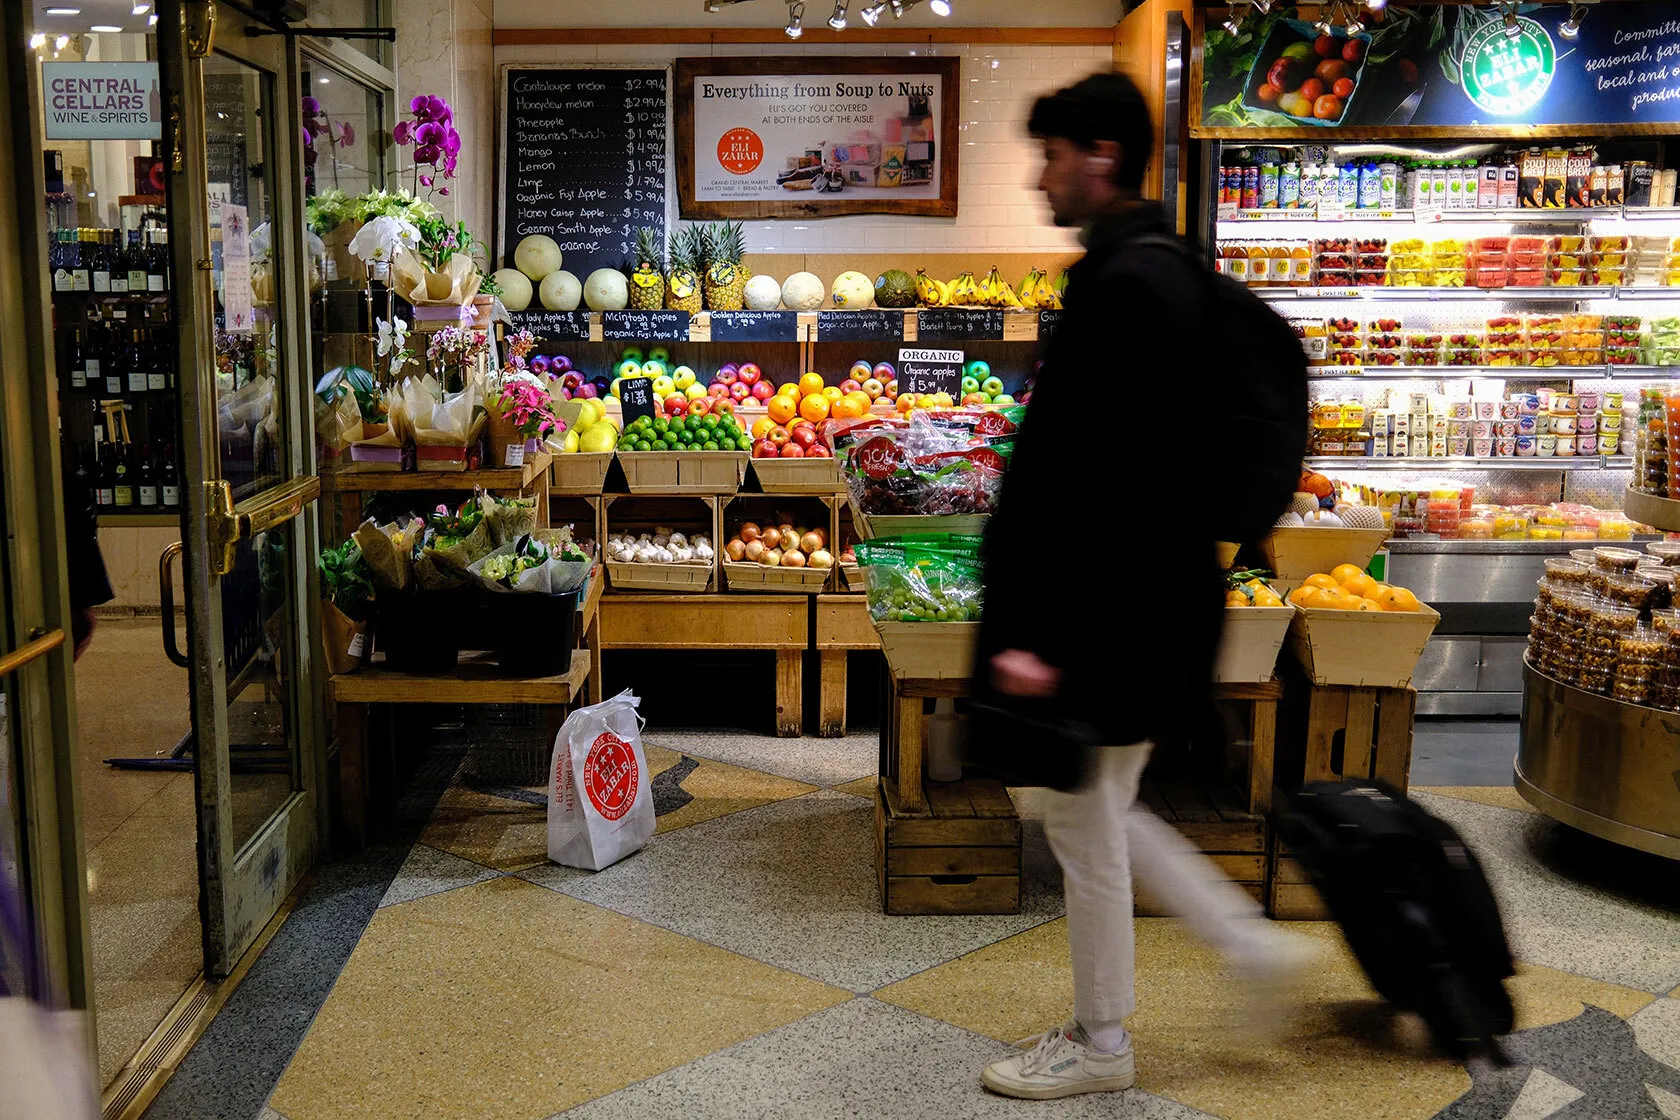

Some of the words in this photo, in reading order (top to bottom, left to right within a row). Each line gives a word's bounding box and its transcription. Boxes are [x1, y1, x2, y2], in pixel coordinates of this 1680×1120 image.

[1465, 37, 1481, 63] NEW
[1481, 21, 1506, 37] YOR
[1518, 20, 1542, 37] CITY
[1585, 46, 1653, 72] seasonal,
[1598, 69, 1637, 91] local
[1637, 65, 1669, 83] and
[52, 78, 145, 93] CENTRAL
[513, 77, 571, 93] Cantaloupe
[577, 81, 606, 91] melon
[703, 84, 788, 100] Everything
[793, 83, 831, 97] from
[836, 82, 874, 99] Soup
[879, 84, 894, 97] to
[898, 82, 934, 97] Nuts
[53, 95, 144, 110] CELLARS
[516, 96, 562, 111] Honeydew
[566, 100, 594, 109] melon
[830, 104, 868, 112] COVERED
[53, 112, 89, 123] WINE
[91, 114, 98, 123] &
[99, 112, 148, 123] SPIRITS
[516, 117, 564, 128] Pineapple
[762, 116, 771, 124] AT
[774, 116, 796, 124] BOTH
[799, 116, 820, 124] ENDS
[854, 115, 874, 123] AISLE
[517, 132, 568, 142] Bananas
[569, 128, 605, 139] Bunch
[519, 147, 552, 157] Mango
[732, 143, 749, 152] ELI
[722, 152, 758, 161] ZABAR
[519, 161, 555, 172] Lemon
[1524, 159, 1546, 168] COLD
[1548, 159, 1568, 168] COLD
[1568, 158, 1591, 167] COLD
[1523, 167, 1545, 177] BREW
[1546, 167, 1567, 176] BREW
[1568, 167, 1591, 176] BREW
[516, 192, 555, 204] Organic
[559, 189, 575, 201] Fuji
[578, 188, 607, 201] Apple
[518, 208, 547, 219] Honey
[551, 208, 575, 218] Crisp
[580, 208, 605, 219] Apple
[517, 222, 554, 235] Granny
[557, 222, 586, 234] Smith
[589, 225, 612, 237] Apple
[560, 241, 600, 254] orange
[527, 313, 541, 324] lady
[544, 313, 566, 323] Apples
[652, 313, 677, 323] Apples
[711, 311, 734, 319] Golden
[763, 312, 781, 320] Apples
[818, 312, 830, 320] Red
[528, 323, 551, 334] Apples
[604, 330, 634, 338] organic
[637, 331, 651, 339] Fuji
[903, 351, 960, 361] ORGANIC
[904, 362, 930, 380] Organic
[932, 364, 956, 380] apples
[982, 417, 1006, 434] JOY
[864, 448, 895, 465] JOY
[607, 733, 623, 744] CIT
[557, 753, 565, 784] MARKET
[600, 759, 617, 783] ELI
[600, 761, 630, 803] ZABAR
